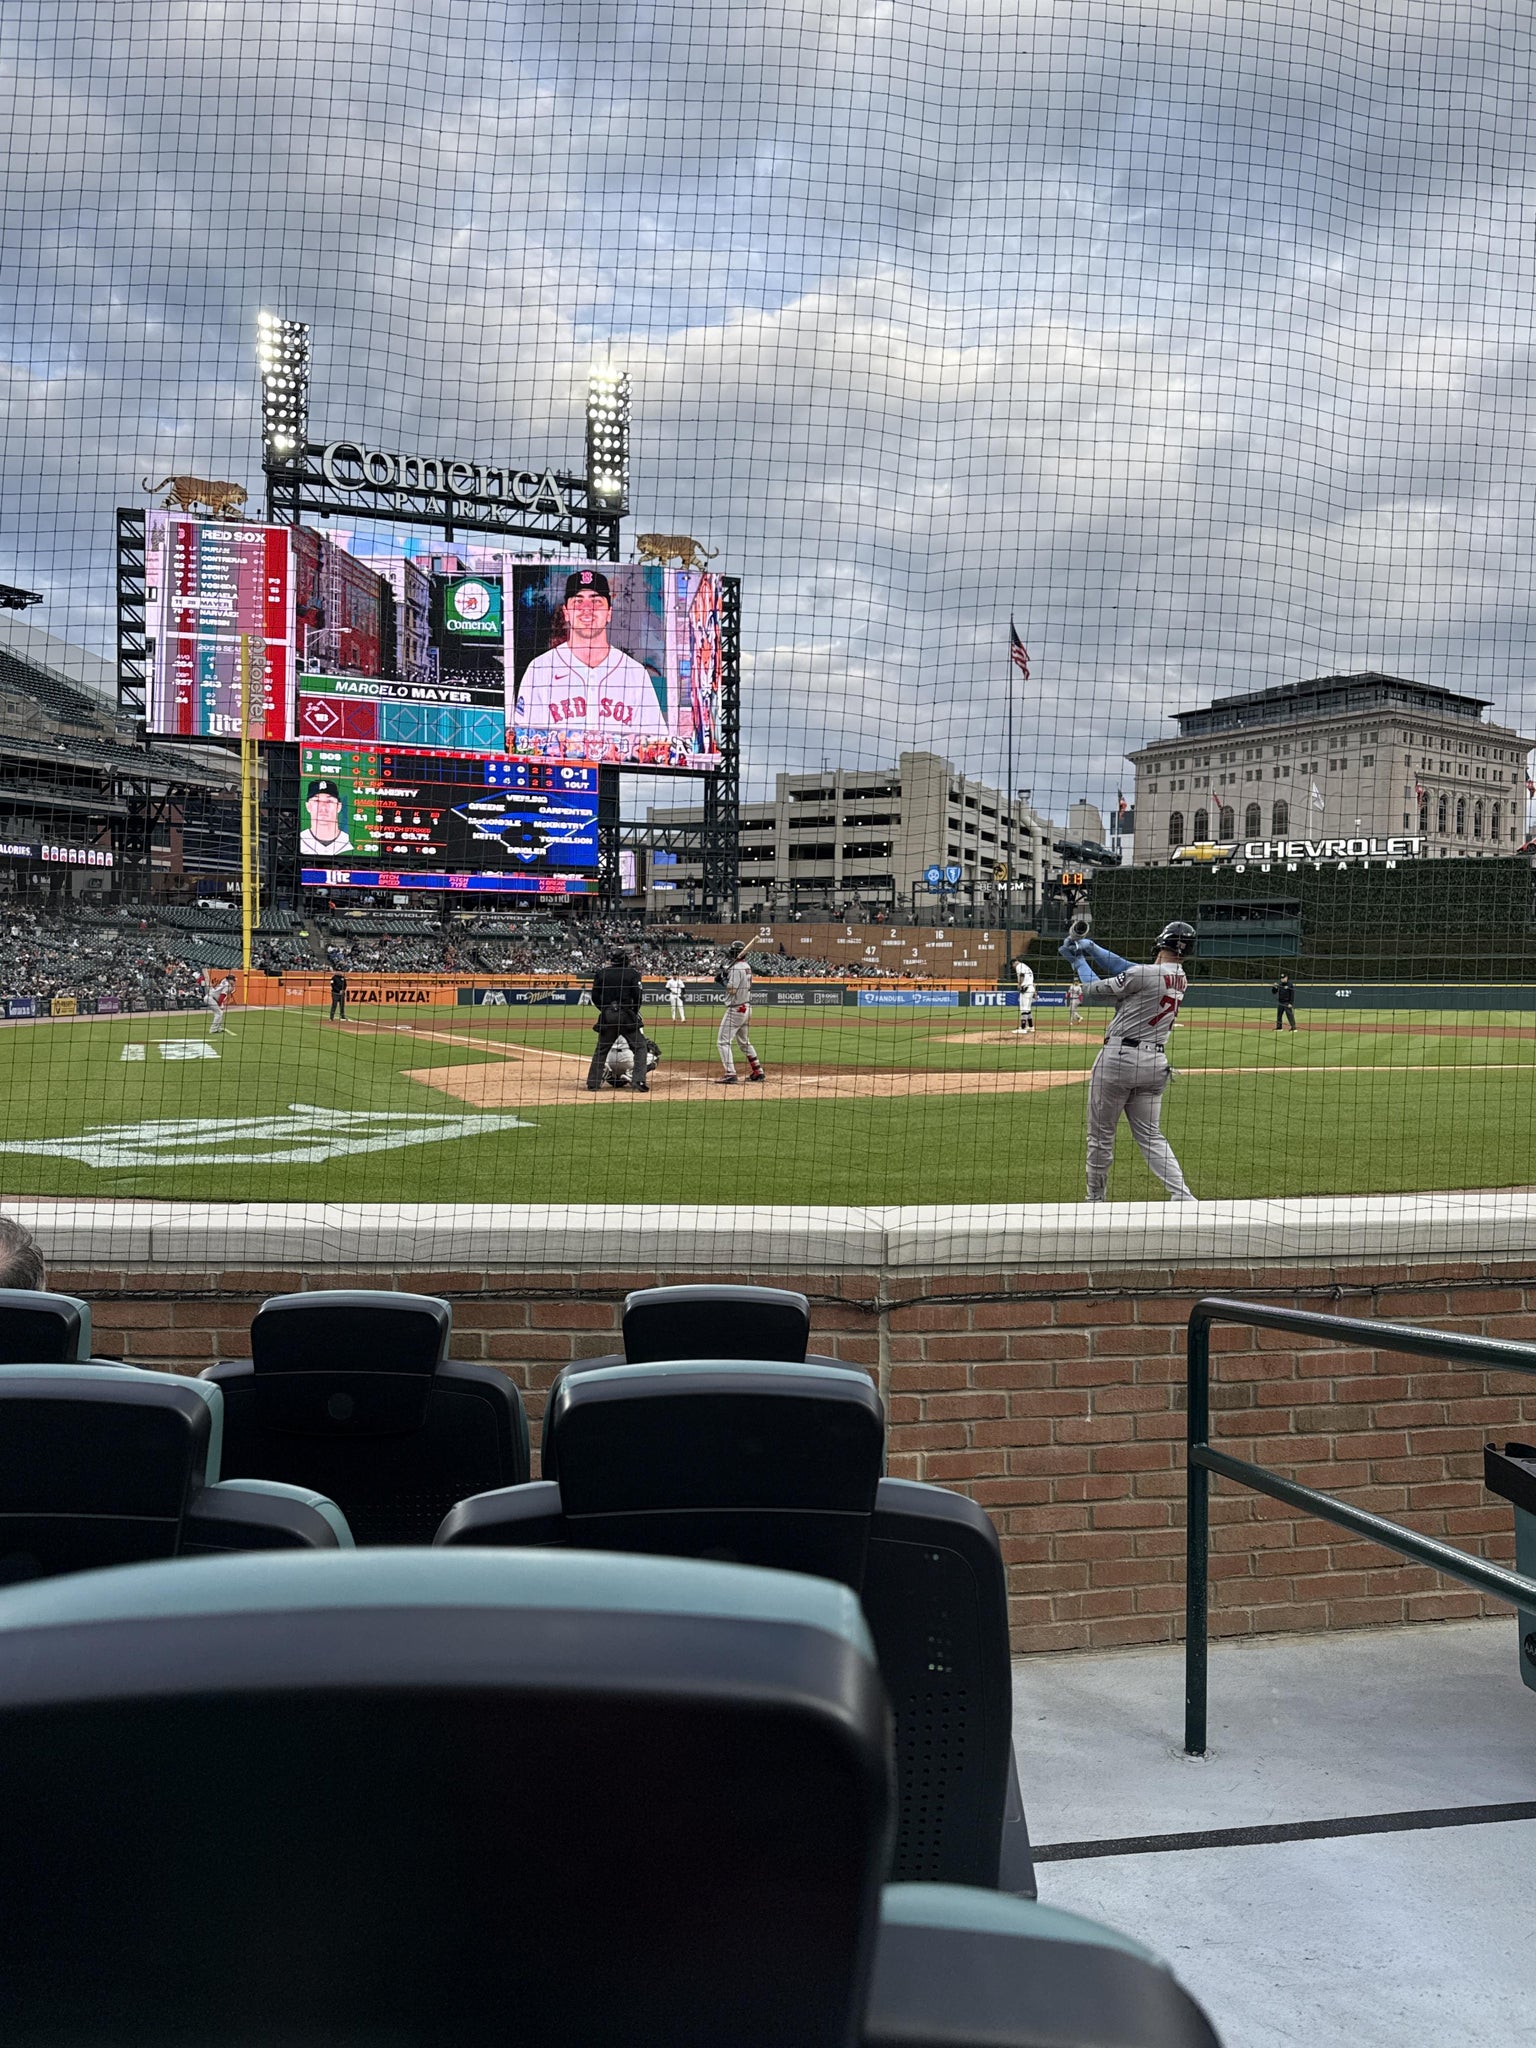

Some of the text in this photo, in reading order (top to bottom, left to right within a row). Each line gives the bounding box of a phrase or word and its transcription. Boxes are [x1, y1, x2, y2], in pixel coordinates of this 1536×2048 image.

[394, 492, 506, 522] PARK
[202, 529, 266, 543] RED SOX
[200, 591, 238, 599] RAFAELA
[335, 681, 472, 702] MARCELO MAYER
[549, 696, 633, 725] RED SOX
[319, 752, 342, 761] BOS
[320, 765, 342, 774] DET
[560, 768, 588, 780] 0-1
[538, 807, 593, 816] CARPENTER
[1245, 837, 1427, 859] CHEVROLET
[1211, 860, 1396, 874] FOUNTAIN
[326, 870, 351, 885] Lite
[760, 927, 771, 936] 23
[846, 927, 852, 936] 5
[890, 929, 896, 938] 2
[935, 930, 944, 939] 16
[865, 946, 876, 955] 47
[912, 948, 918, 957] 3
[346, 991, 430, 1003] IZZA! PIZZA!
[694, 993, 726, 1002] BETMG
[975, 993, 1006, 1005] DTE
